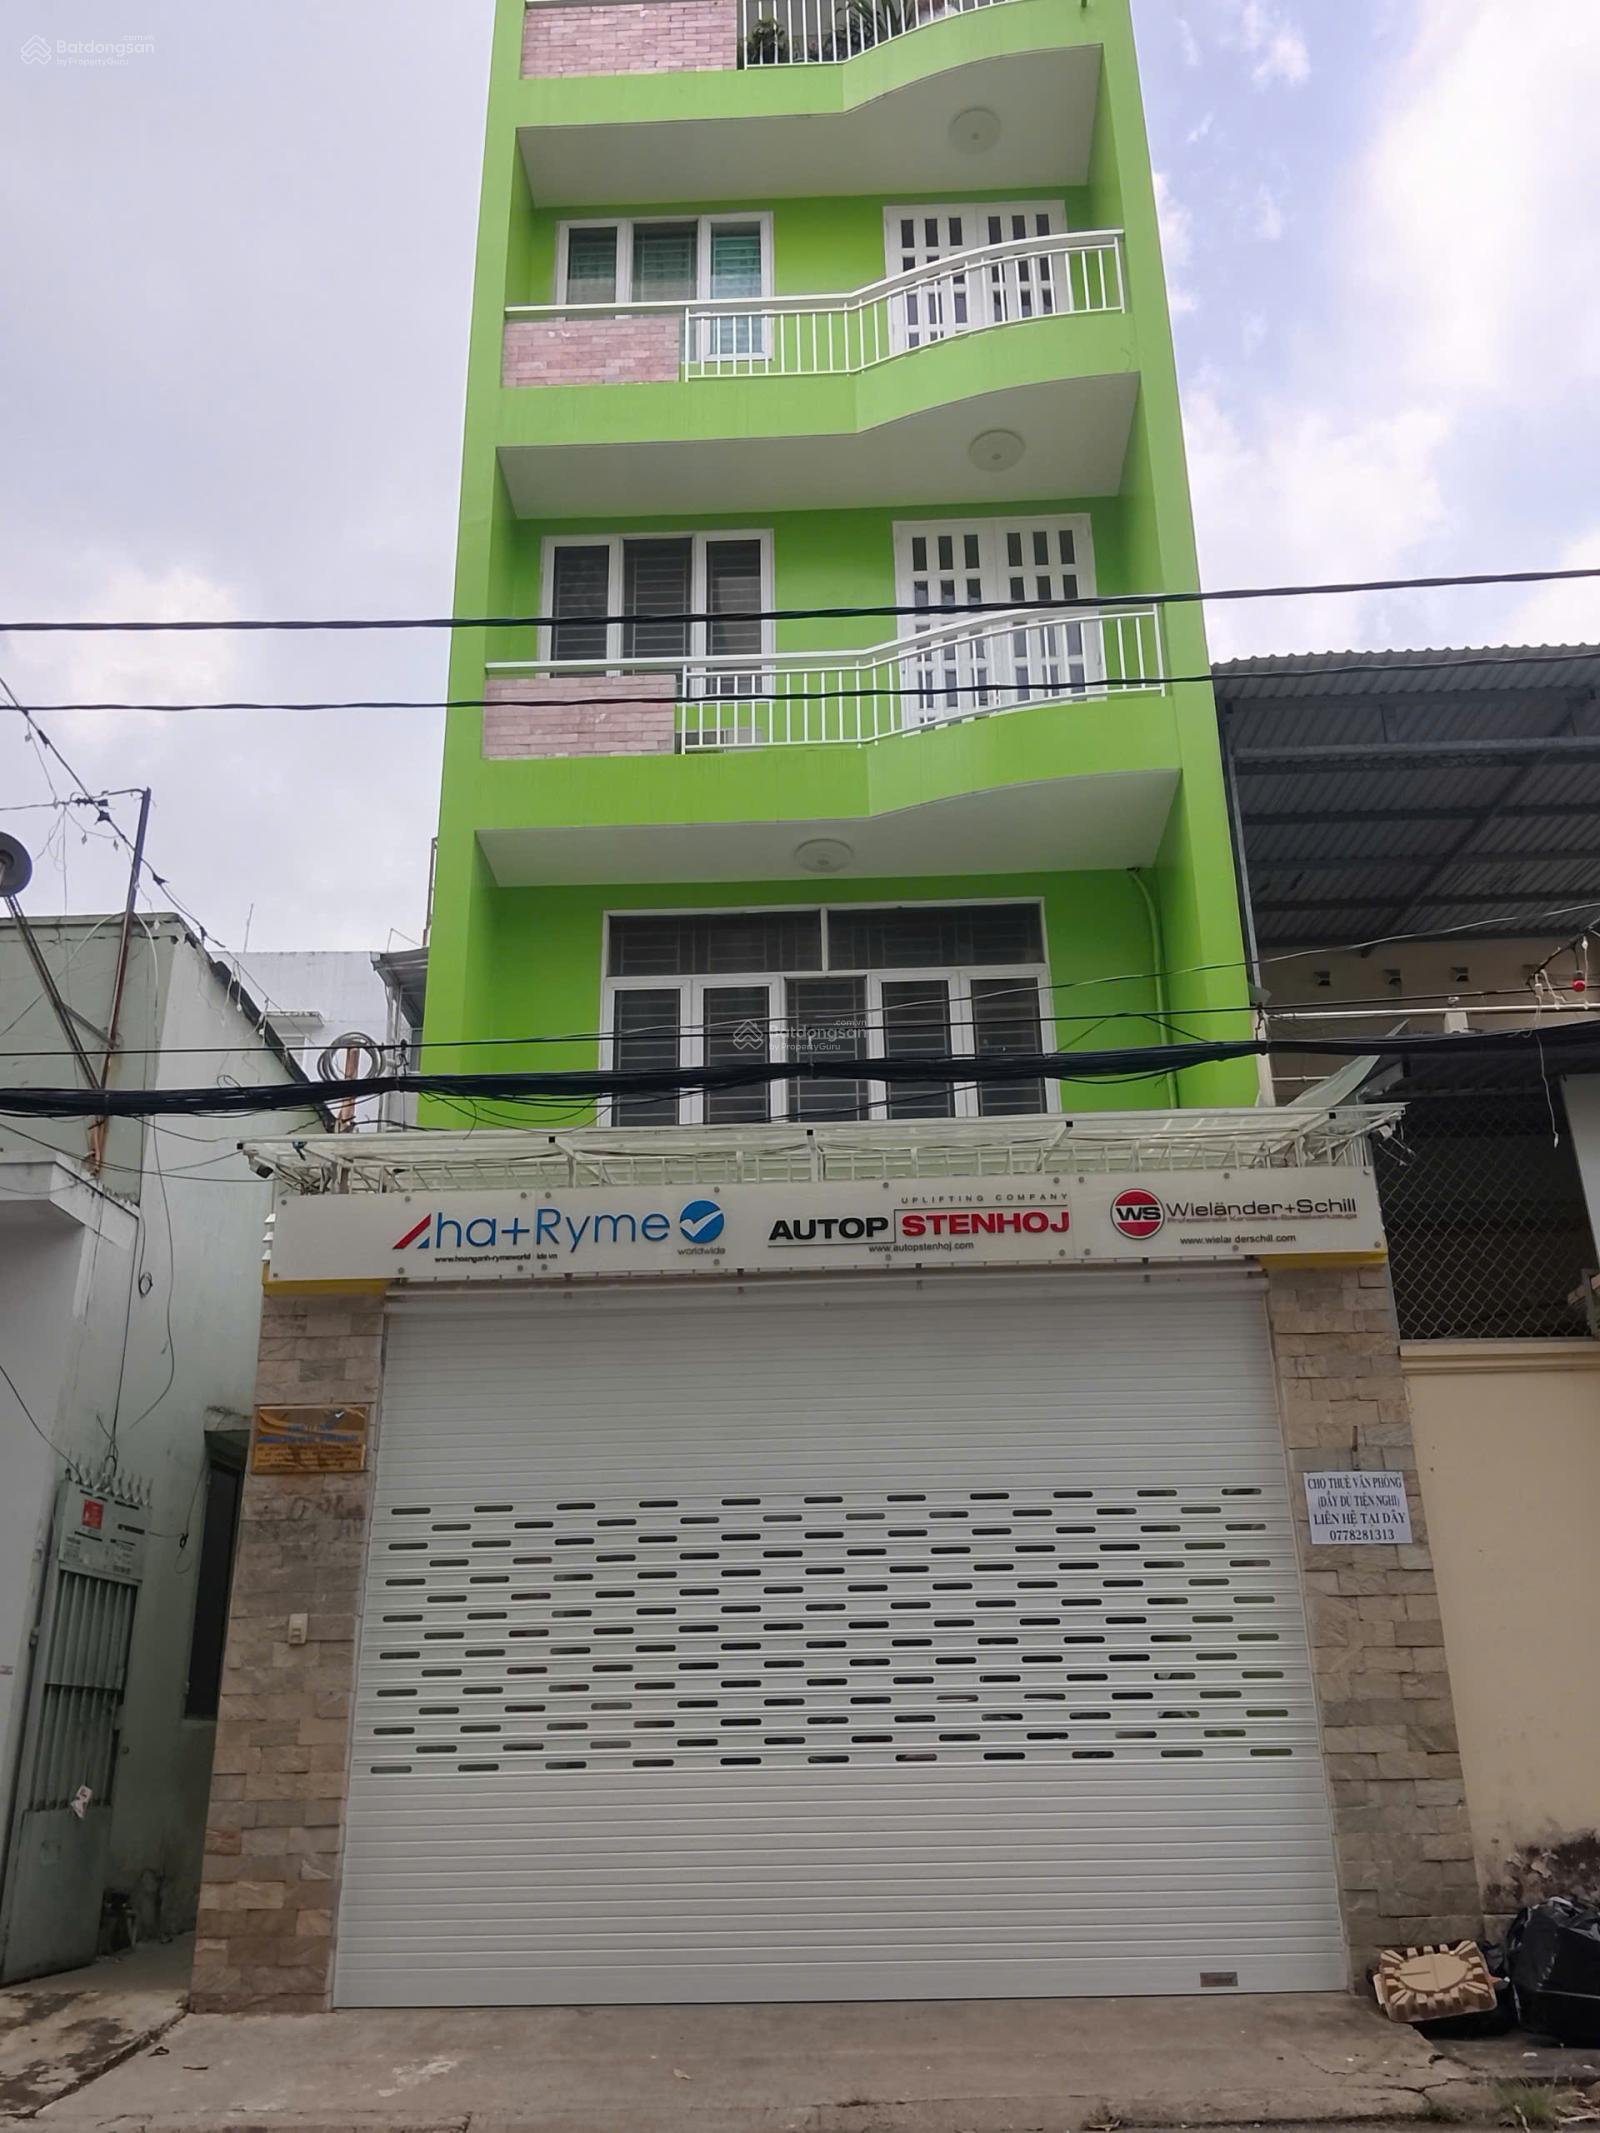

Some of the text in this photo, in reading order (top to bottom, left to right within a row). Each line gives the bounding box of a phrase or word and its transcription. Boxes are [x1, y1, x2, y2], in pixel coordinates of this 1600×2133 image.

[901, 1193, 1068, 1204] UPLIFTING COMPANY
[1115, 1205, 1161, 1221] WS
[1165, 1198, 1357, 1217] Wieländer+Schill
[768, 1210, 1070, 1241] AUTOP STENHOJ
[677, 1246, 726, 1256] worldwide
[868, 1240, 974, 1254] www.autopstenhoj.com
[1307, 1477, 1327, 1490] CHO
[1313, 1510, 1340, 1525] LIÊN
[1329, 1528, 1395, 1541] 0778281313
